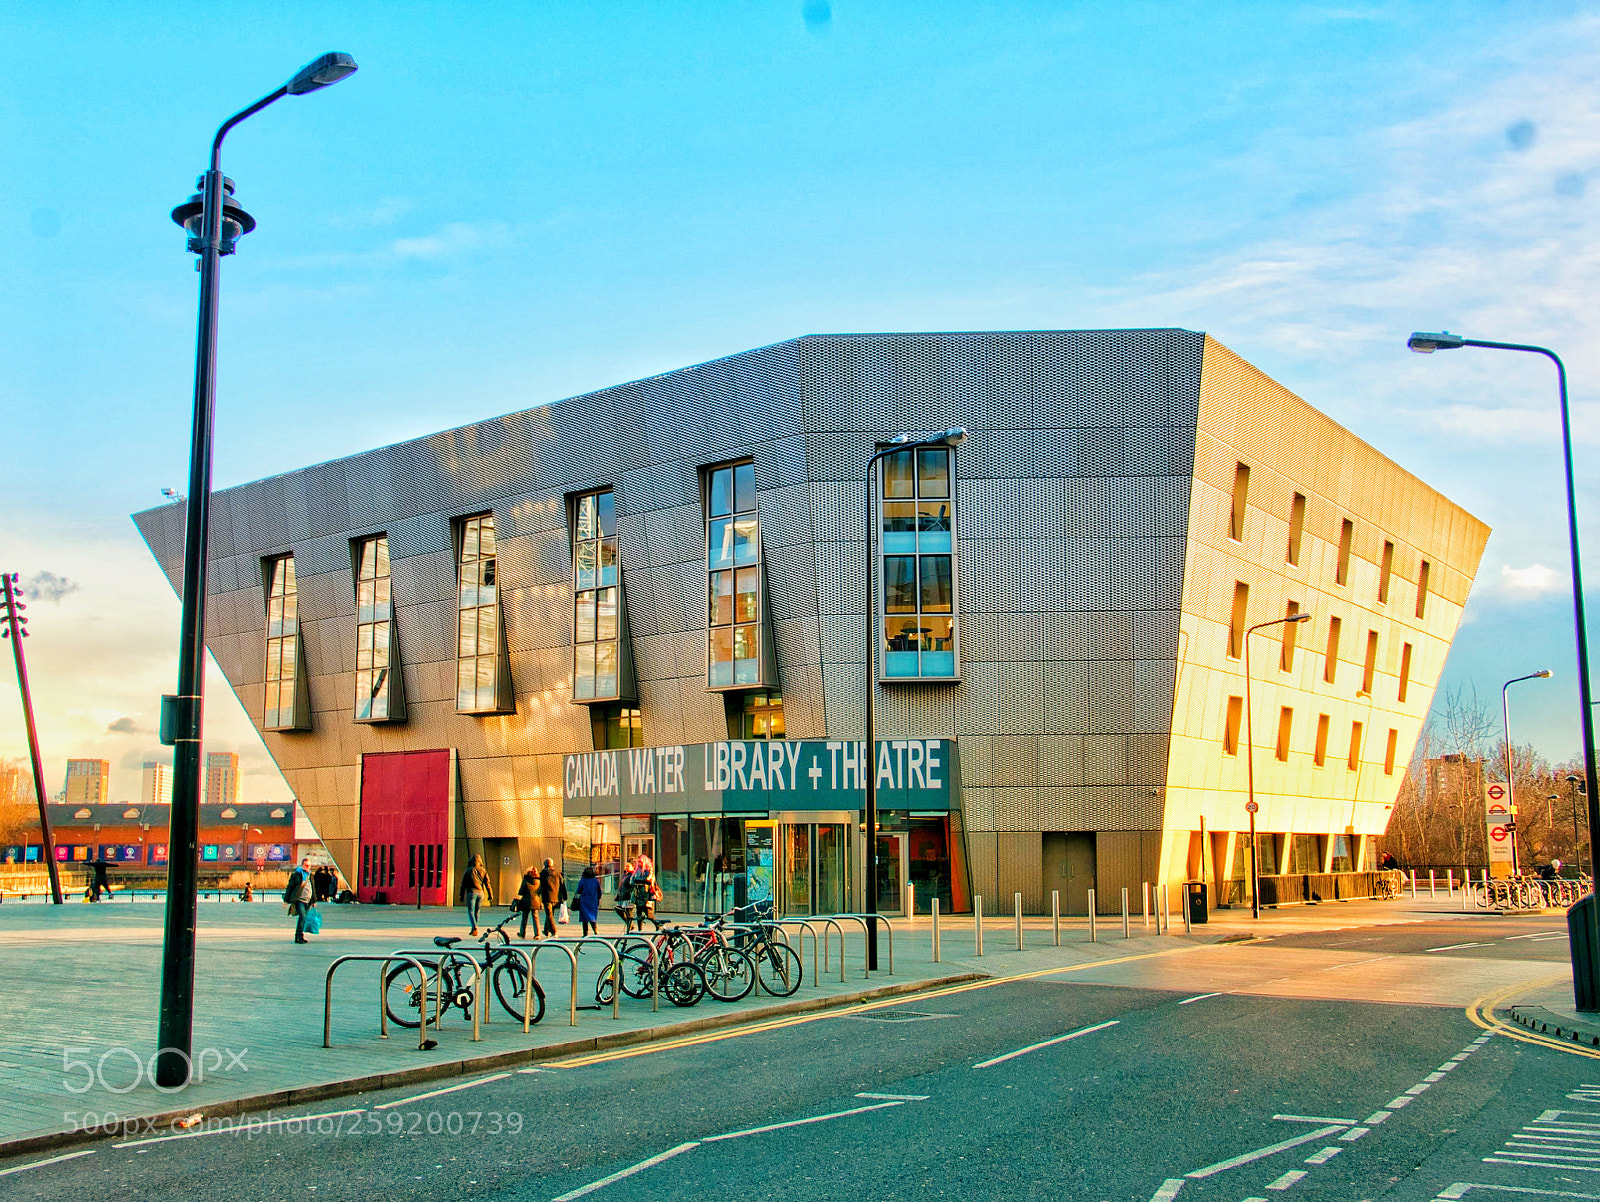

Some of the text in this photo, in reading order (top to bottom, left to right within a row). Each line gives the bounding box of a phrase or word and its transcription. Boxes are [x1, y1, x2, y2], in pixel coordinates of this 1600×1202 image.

[566, 750, 619, 799] CANADA
[628, 745, 685, 795] WATER
[704, 740, 802, 791] LIBRARY
